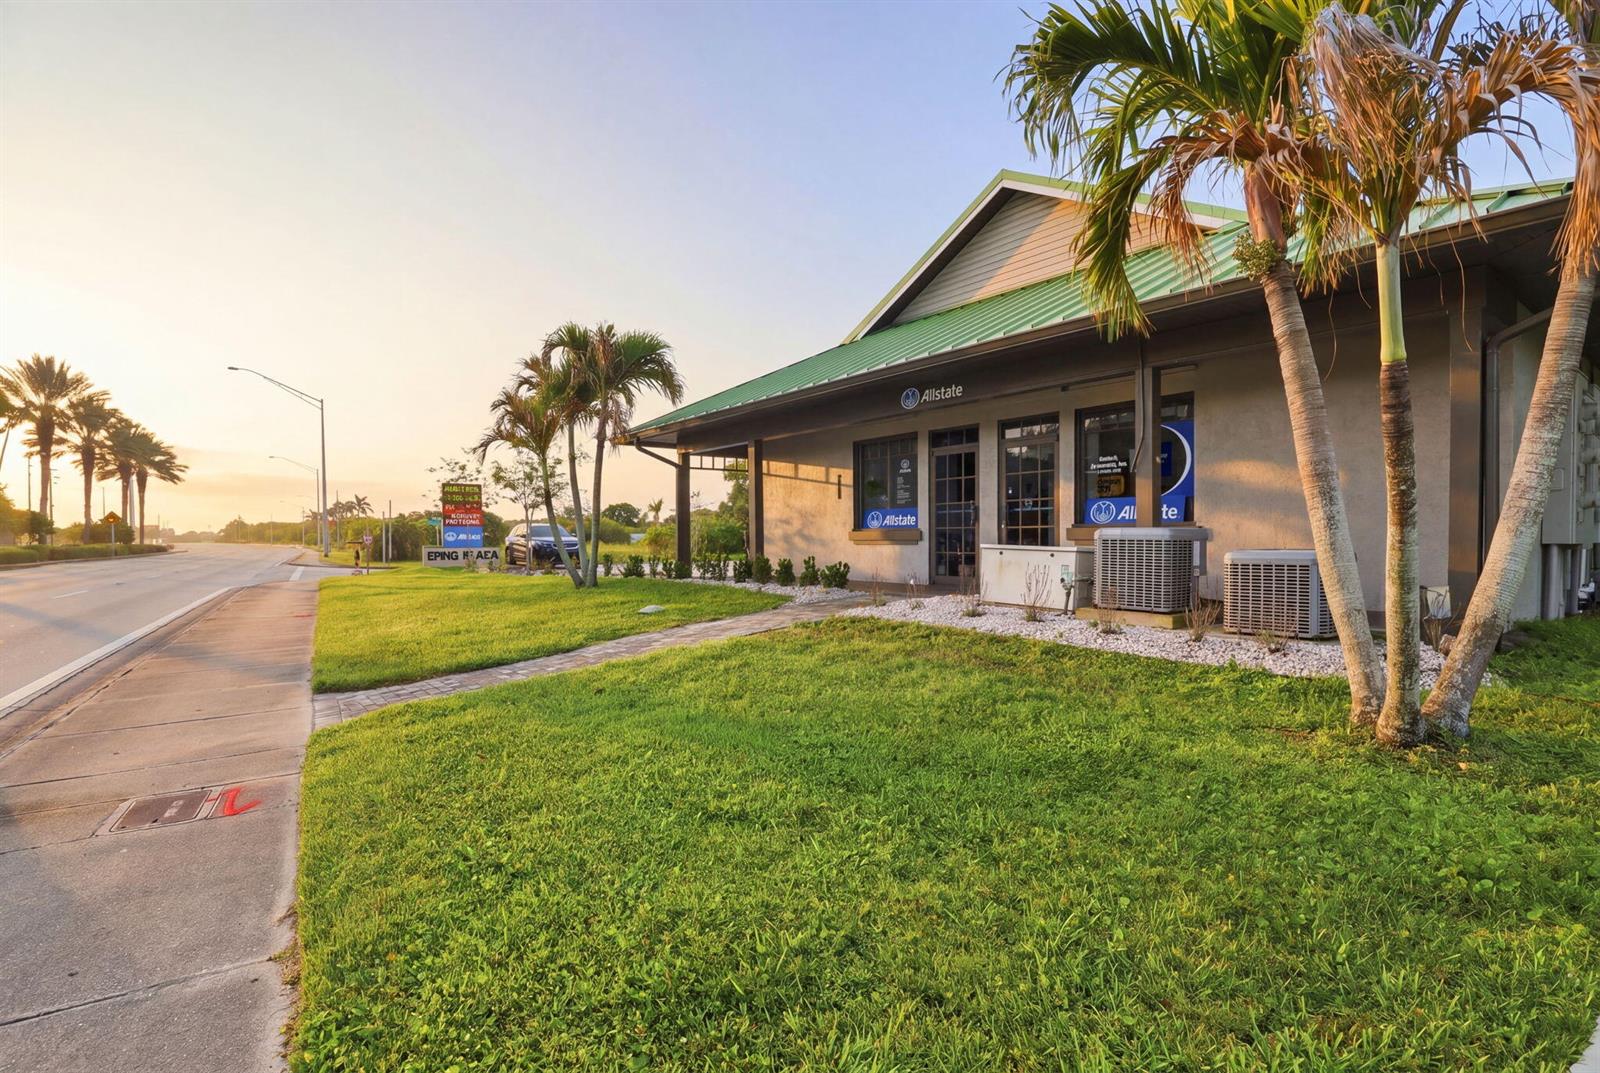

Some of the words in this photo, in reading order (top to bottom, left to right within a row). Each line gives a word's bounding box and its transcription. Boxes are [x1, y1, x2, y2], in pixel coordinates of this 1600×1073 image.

[920, 384, 963, 403] Allstate
[882, 513, 916, 526] Allstate
[1117, 504, 1178, 520] Allte
